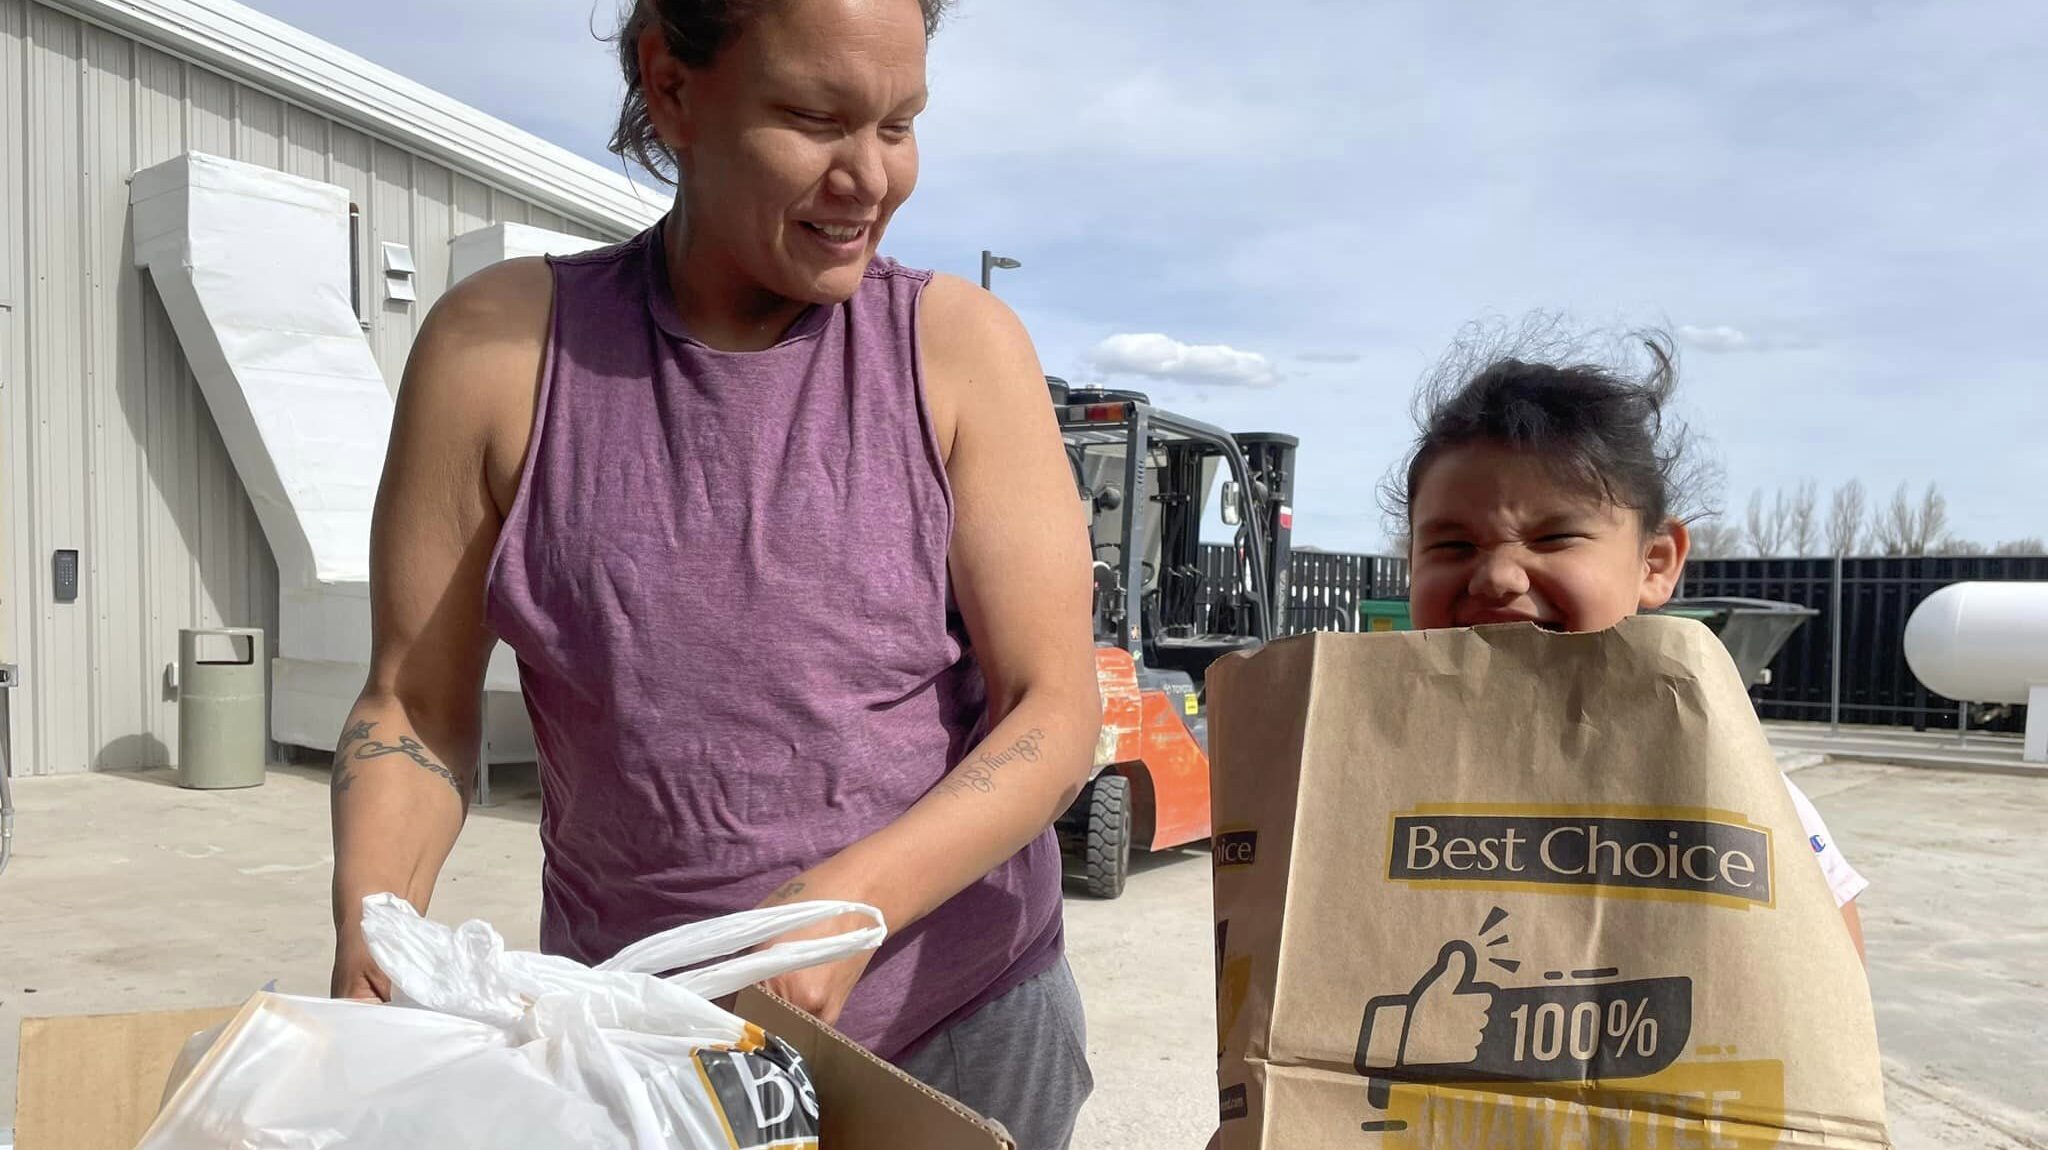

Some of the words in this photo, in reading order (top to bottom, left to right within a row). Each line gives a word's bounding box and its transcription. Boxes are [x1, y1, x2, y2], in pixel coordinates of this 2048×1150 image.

[1406, 825, 1526, 872] Best
[1539, 825, 1756, 888] Choice
[1510, 997, 1658, 1062] 100%
